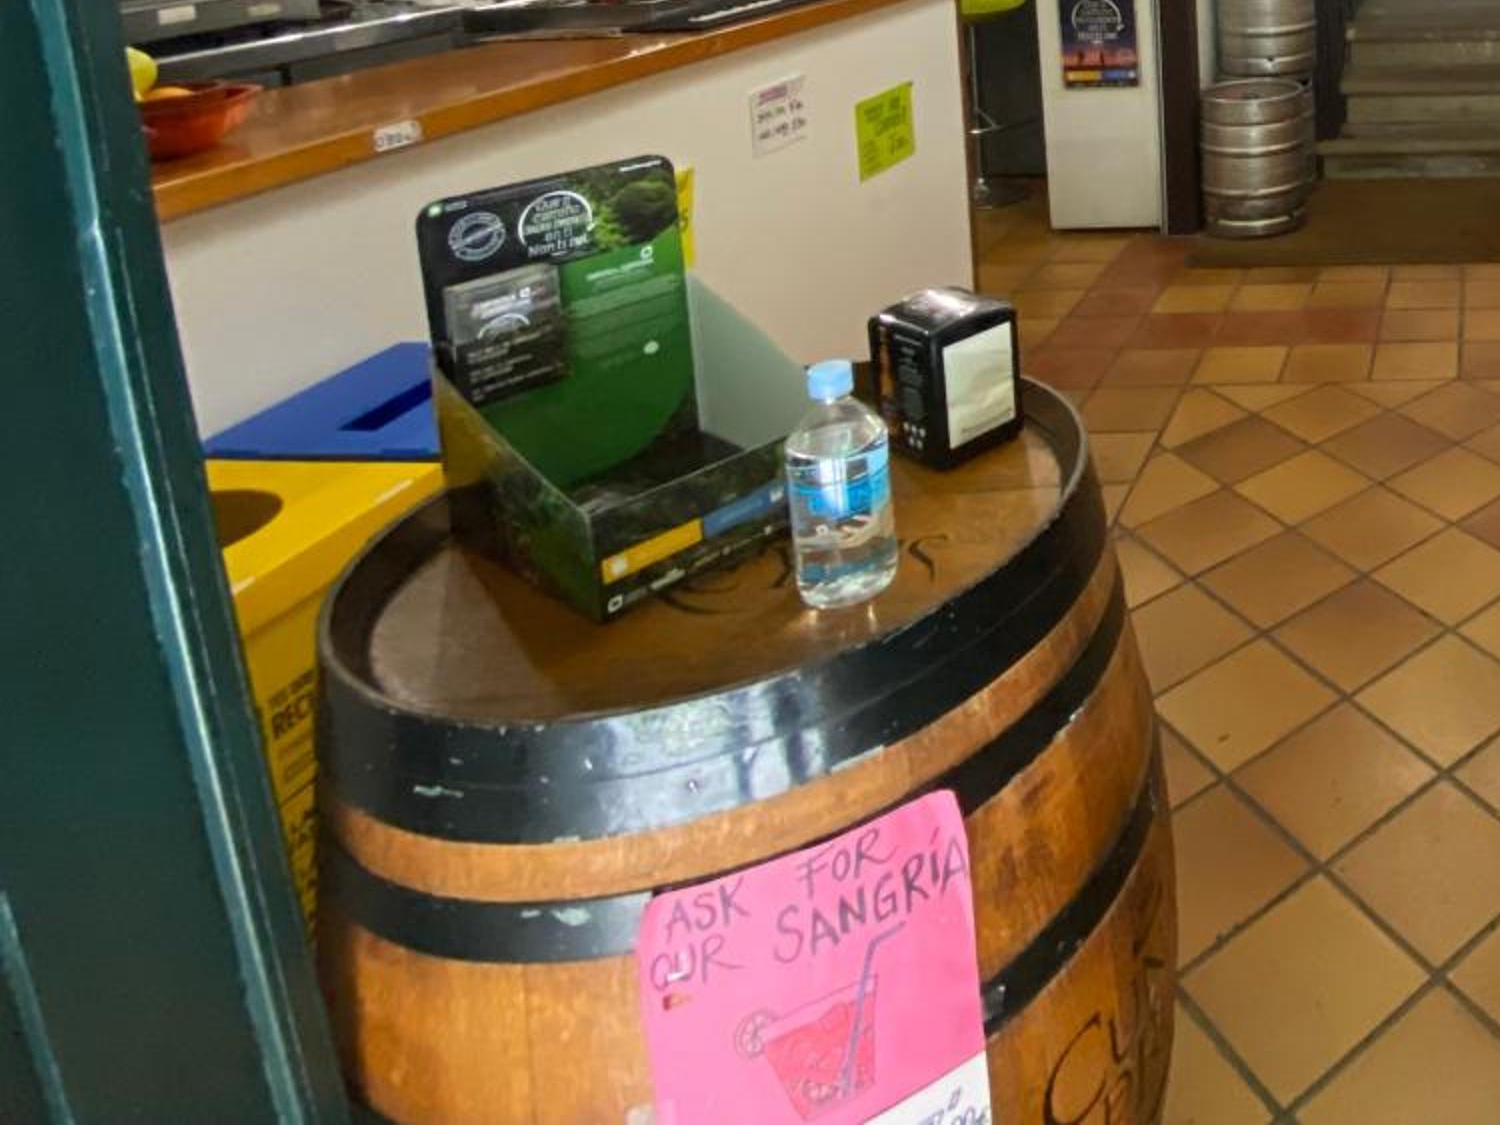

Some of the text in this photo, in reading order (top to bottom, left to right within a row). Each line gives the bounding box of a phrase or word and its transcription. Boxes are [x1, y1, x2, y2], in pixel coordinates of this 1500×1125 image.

[648, 826, 970, 990] OUR SANGRÍA
[664, 828, 899, 942] ASK FOR
